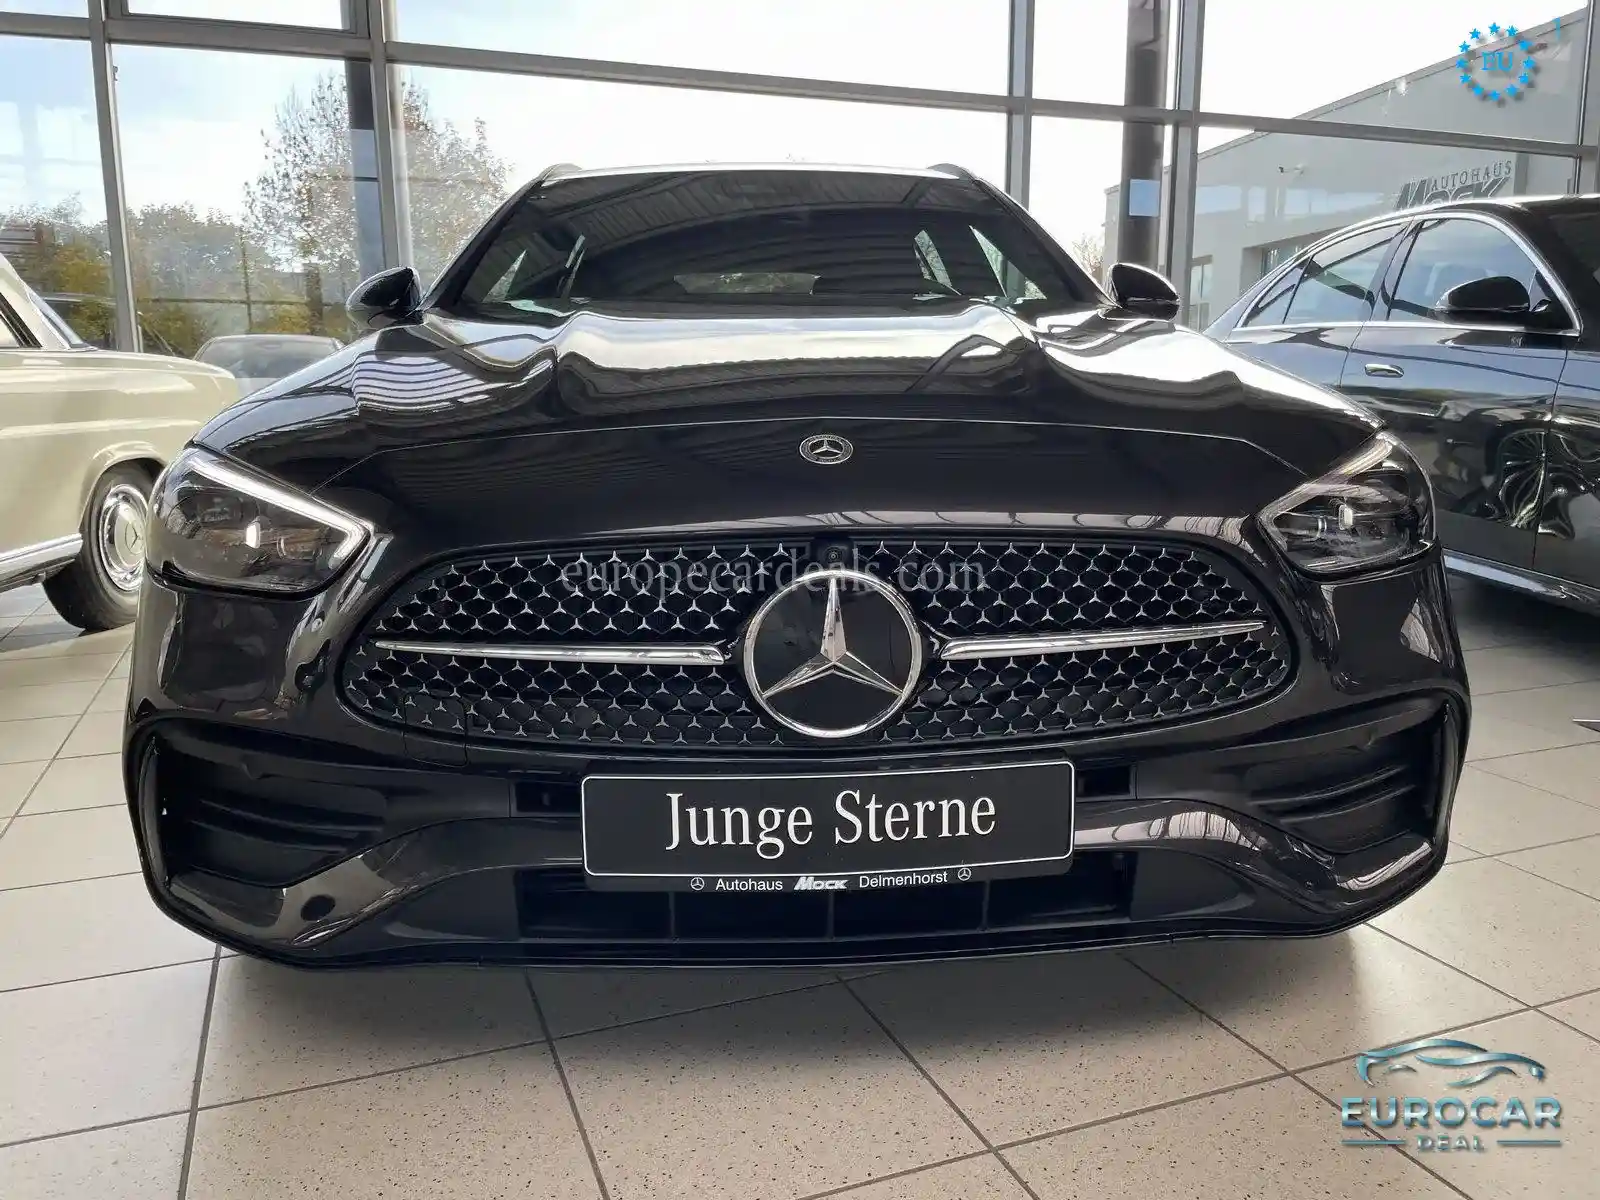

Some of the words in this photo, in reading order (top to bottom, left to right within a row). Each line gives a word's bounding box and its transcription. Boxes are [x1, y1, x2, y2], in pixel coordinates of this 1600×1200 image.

[1430, 160, 1512, 191] AUTOHAUS
[665, 792, 813, 860] Junge
[834, 788, 997, 846] Sterne
[715, 878, 784, 891] Autohaus
[859, 871, 948, 888] Delmenhorst
